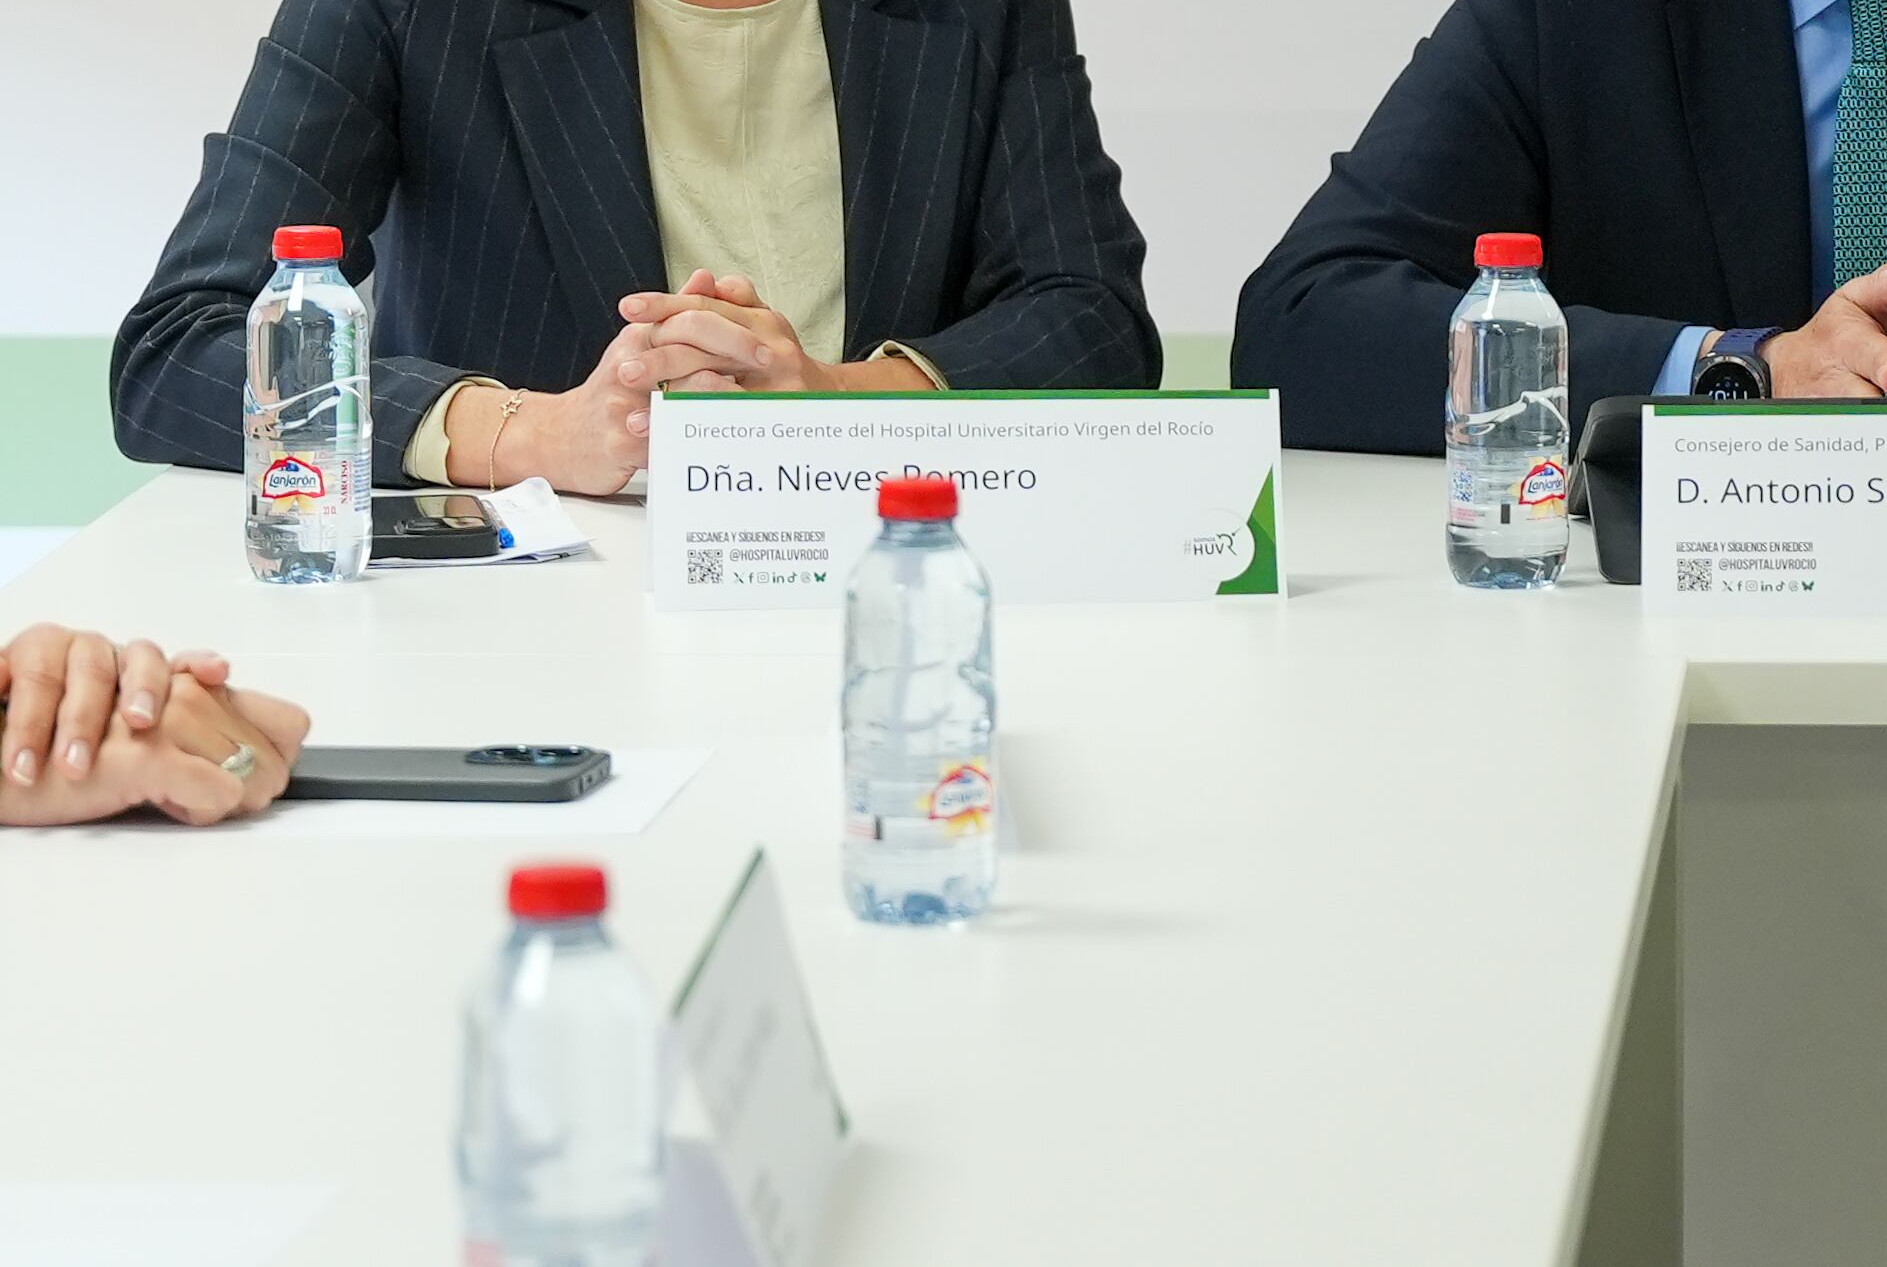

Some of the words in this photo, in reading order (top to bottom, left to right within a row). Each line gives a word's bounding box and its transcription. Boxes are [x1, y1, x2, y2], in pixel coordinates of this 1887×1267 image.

[684, 423, 766, 439] Directora
[771, 423, 842, 439] Gerente
[848, 422, 875, 438] del
[880, 422, 952, 442] Hospital
[957, 421, 1070, 438] Universitario
[1074, 421, 1131, 441] Virgen
[1136, 420, 1162, 436] del
[1167, 420, 1214, 436] Rocío
[1674, 437, 1763, 457] Consejero
[1767, 436, 1789, 453] de
[1794, 436, 1869, 455] Sanidad,
[269, 473, 317, 488] Lanjarón
[687, 464, 763, 493] Dña.
[778, 464, 889, 492] Nieves
[1677, 477, 1709, 505] D.
[1720, 476, 1855, 504] Antonio
[730, 531, 737, 543] Y
[781, 531, 793, 543] EN
[1720, 541, 1726, 553] Y
[1769, 541, 1781, 553] EN
